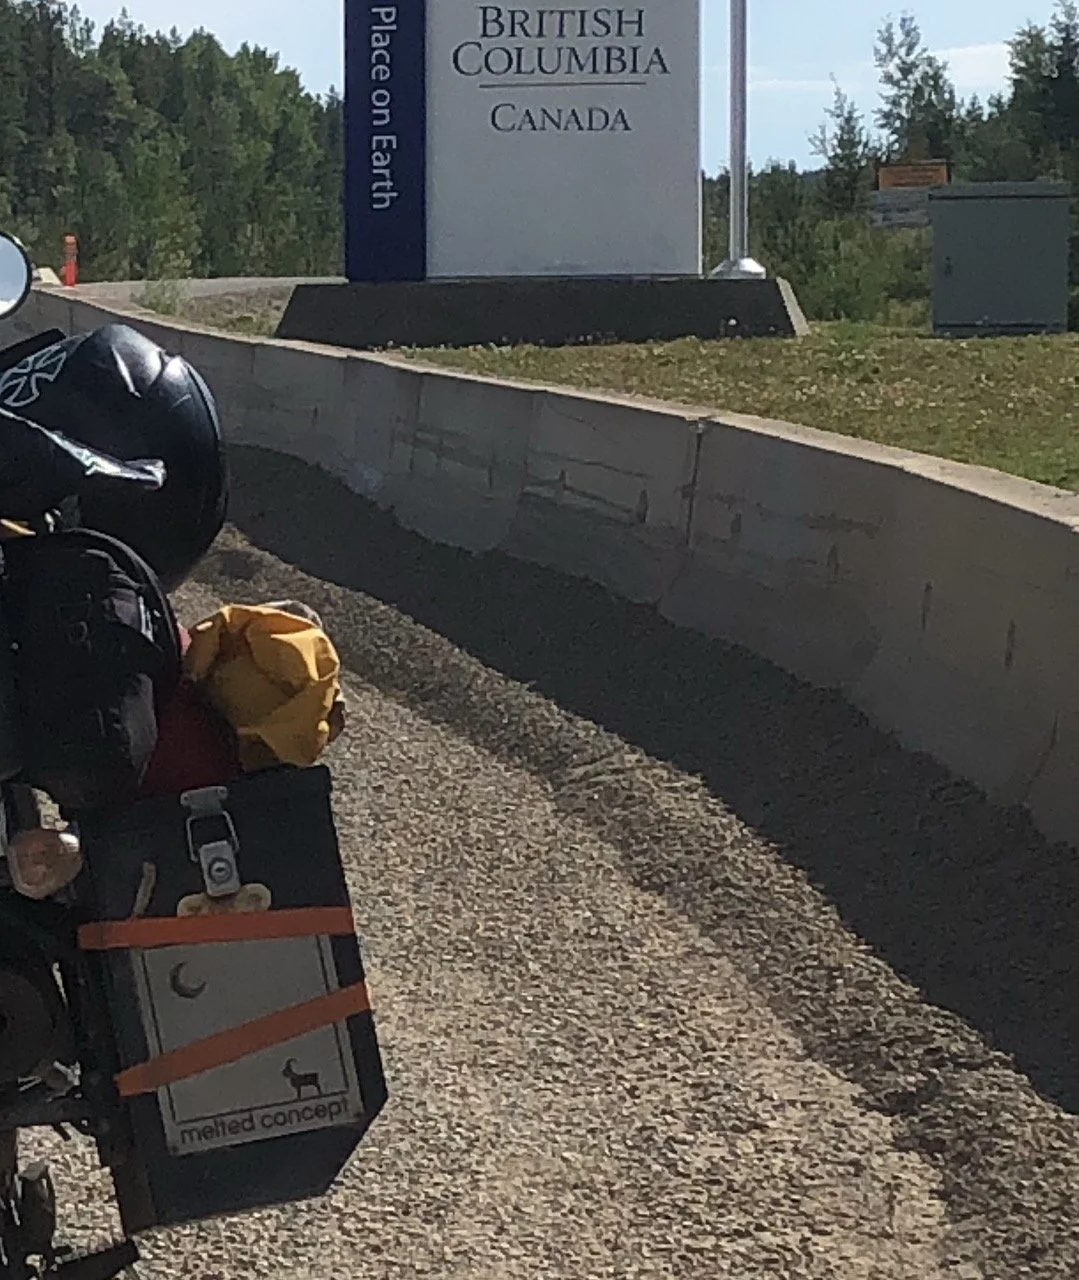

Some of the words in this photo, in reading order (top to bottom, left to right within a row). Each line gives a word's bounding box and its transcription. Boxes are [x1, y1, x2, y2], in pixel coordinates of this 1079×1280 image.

[478, 5, 645, 39] BRITISH
[370, 6, 398, 81] Place
[452, 40, 671, 77] COLUMBIA
[370, 88, 391, 127] on
[490, 102, 633, 133] CANADA
[370, 134, 399, 210] Earth
[180, 1111, 256, 1145] melted
[260, 1097, 350, 1129] concept
